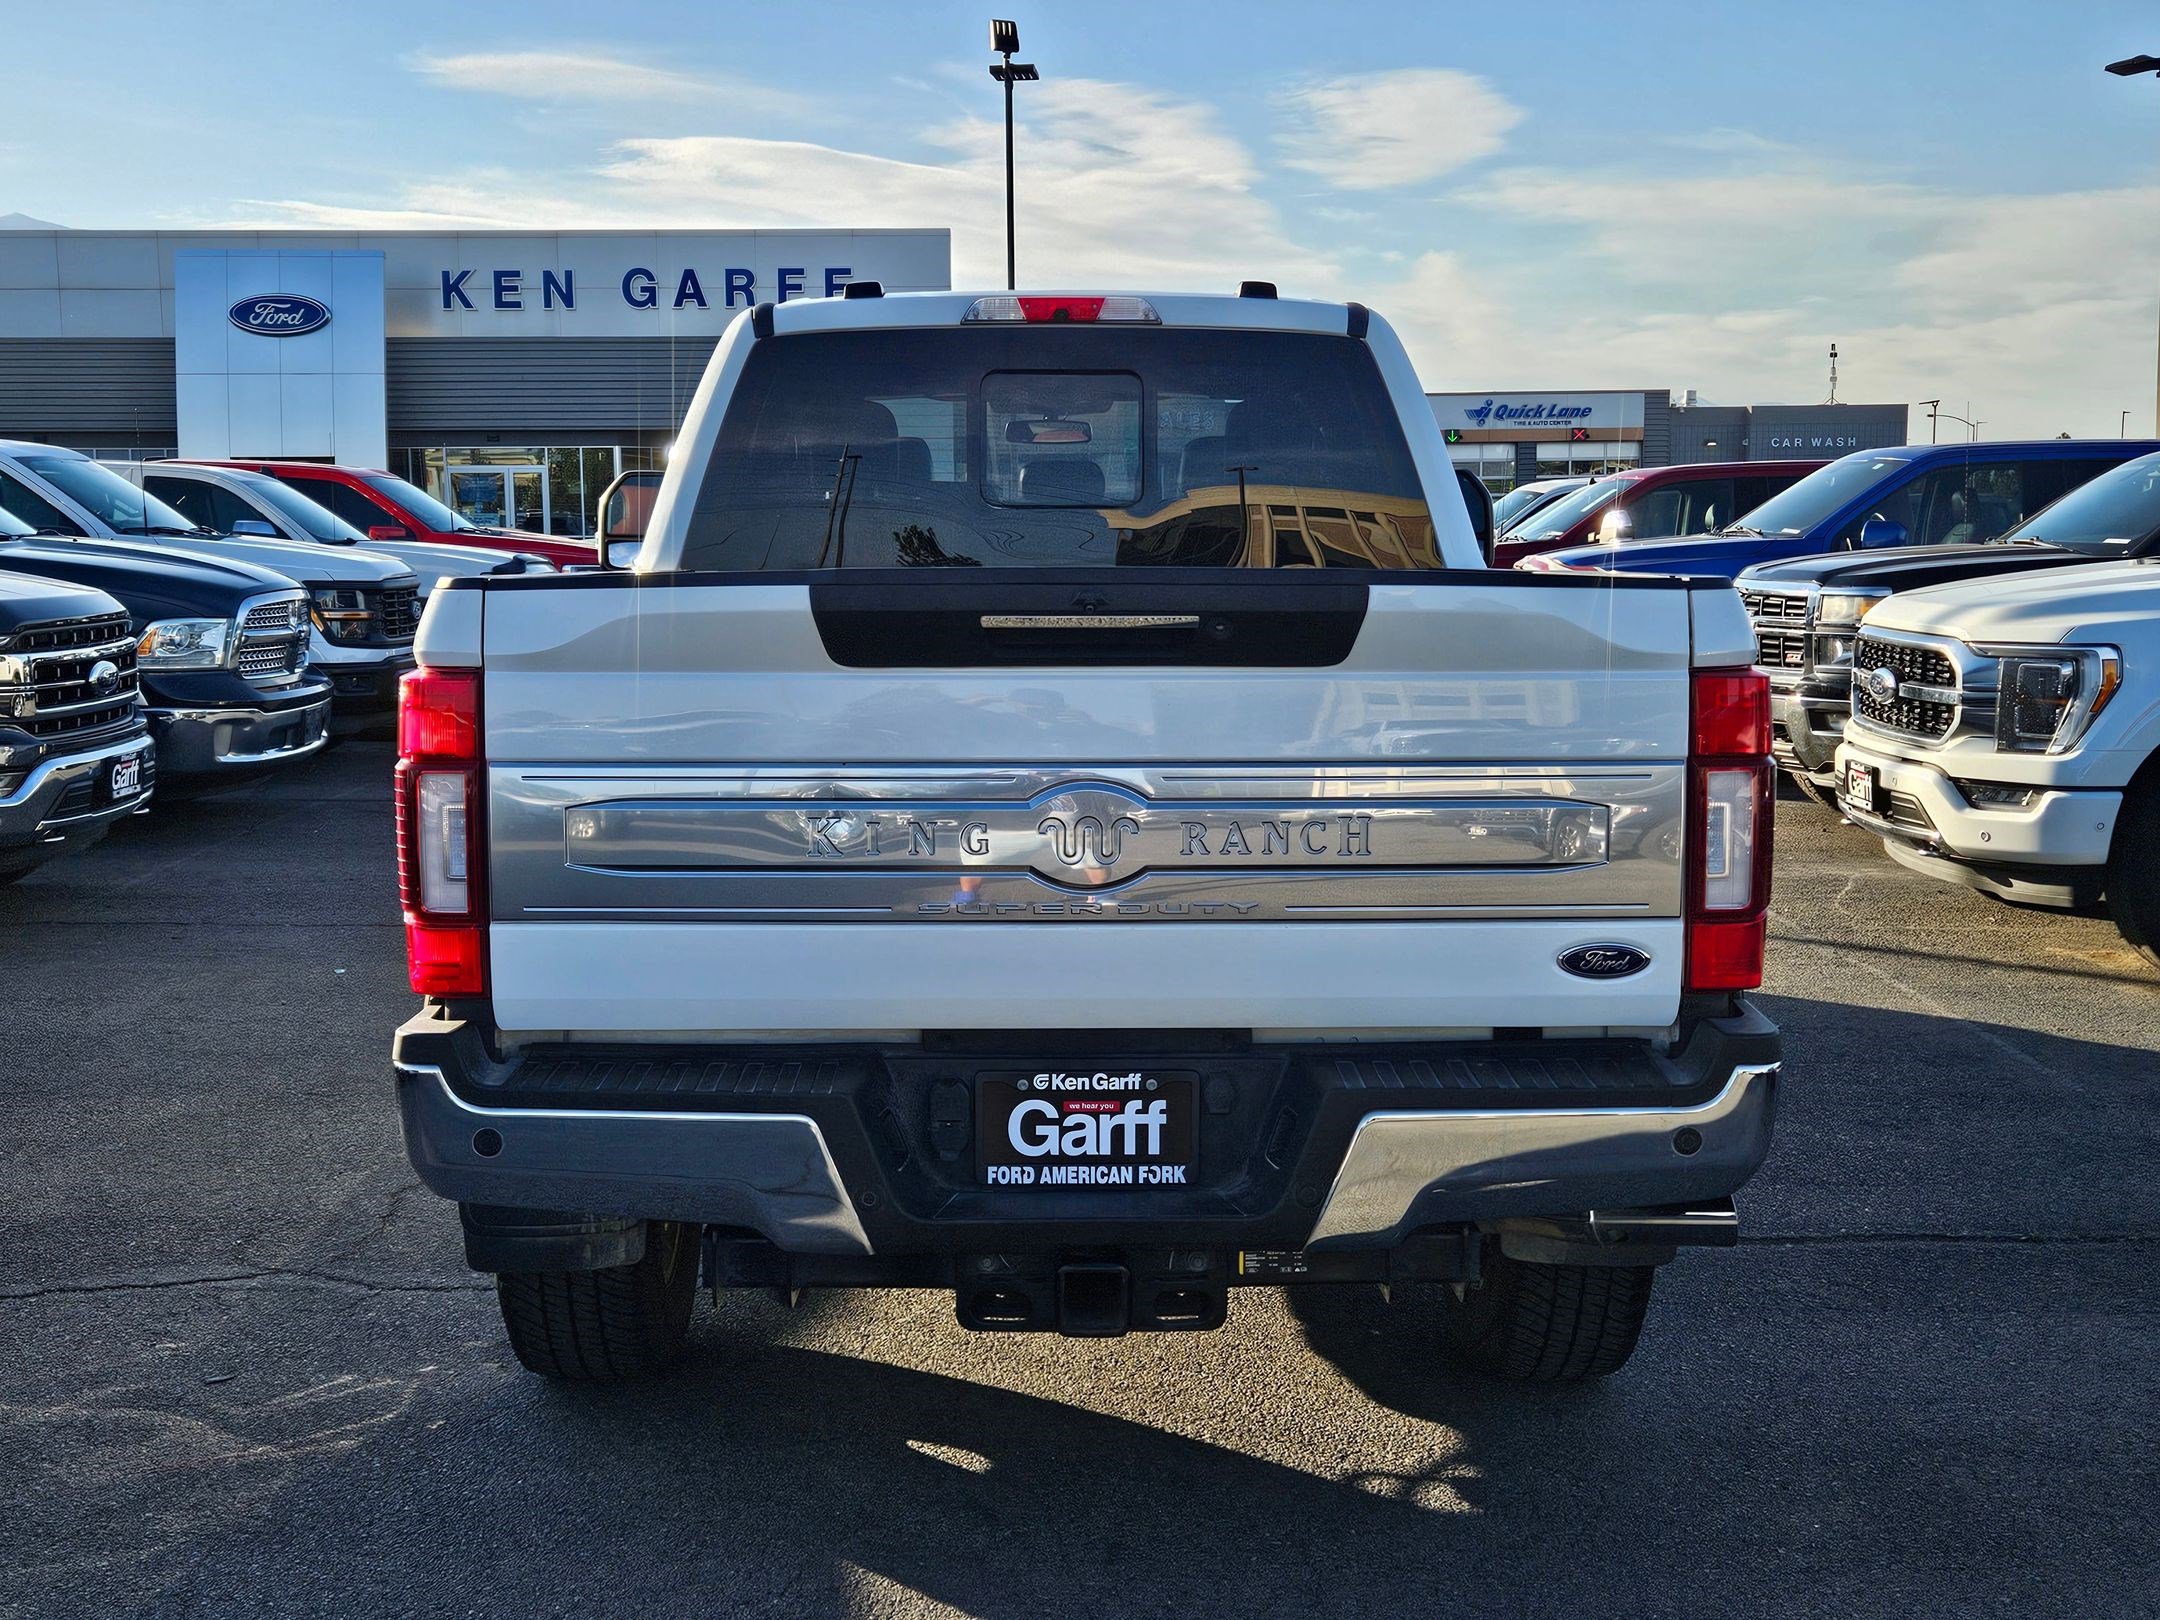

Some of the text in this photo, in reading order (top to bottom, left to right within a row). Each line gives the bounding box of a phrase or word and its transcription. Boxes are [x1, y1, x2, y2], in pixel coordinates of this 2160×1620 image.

[440, 266, 854, 312] KEN GARFF
[249, 302, 305, 325] Ford
[1493, 403, 1593, 420] Quick Lane
[1771, 437, 1857, 447] CAR WASH
[806, 815, 1373, 858] KING RANCH
[918, 902, 1260, 916] SUPER DUTY
[1580, 950, 1631, 971] Ford
[1051, 1073, 1142, 1091] Ken Garff
[1081, 1101, 1099, 1109] hear
[1100, 1103, 1114, 1111] you
[1007, 1099, 1168, 1157] Garff
[987, 1165, 1187, 1185] FORD AMERICAN FORK
